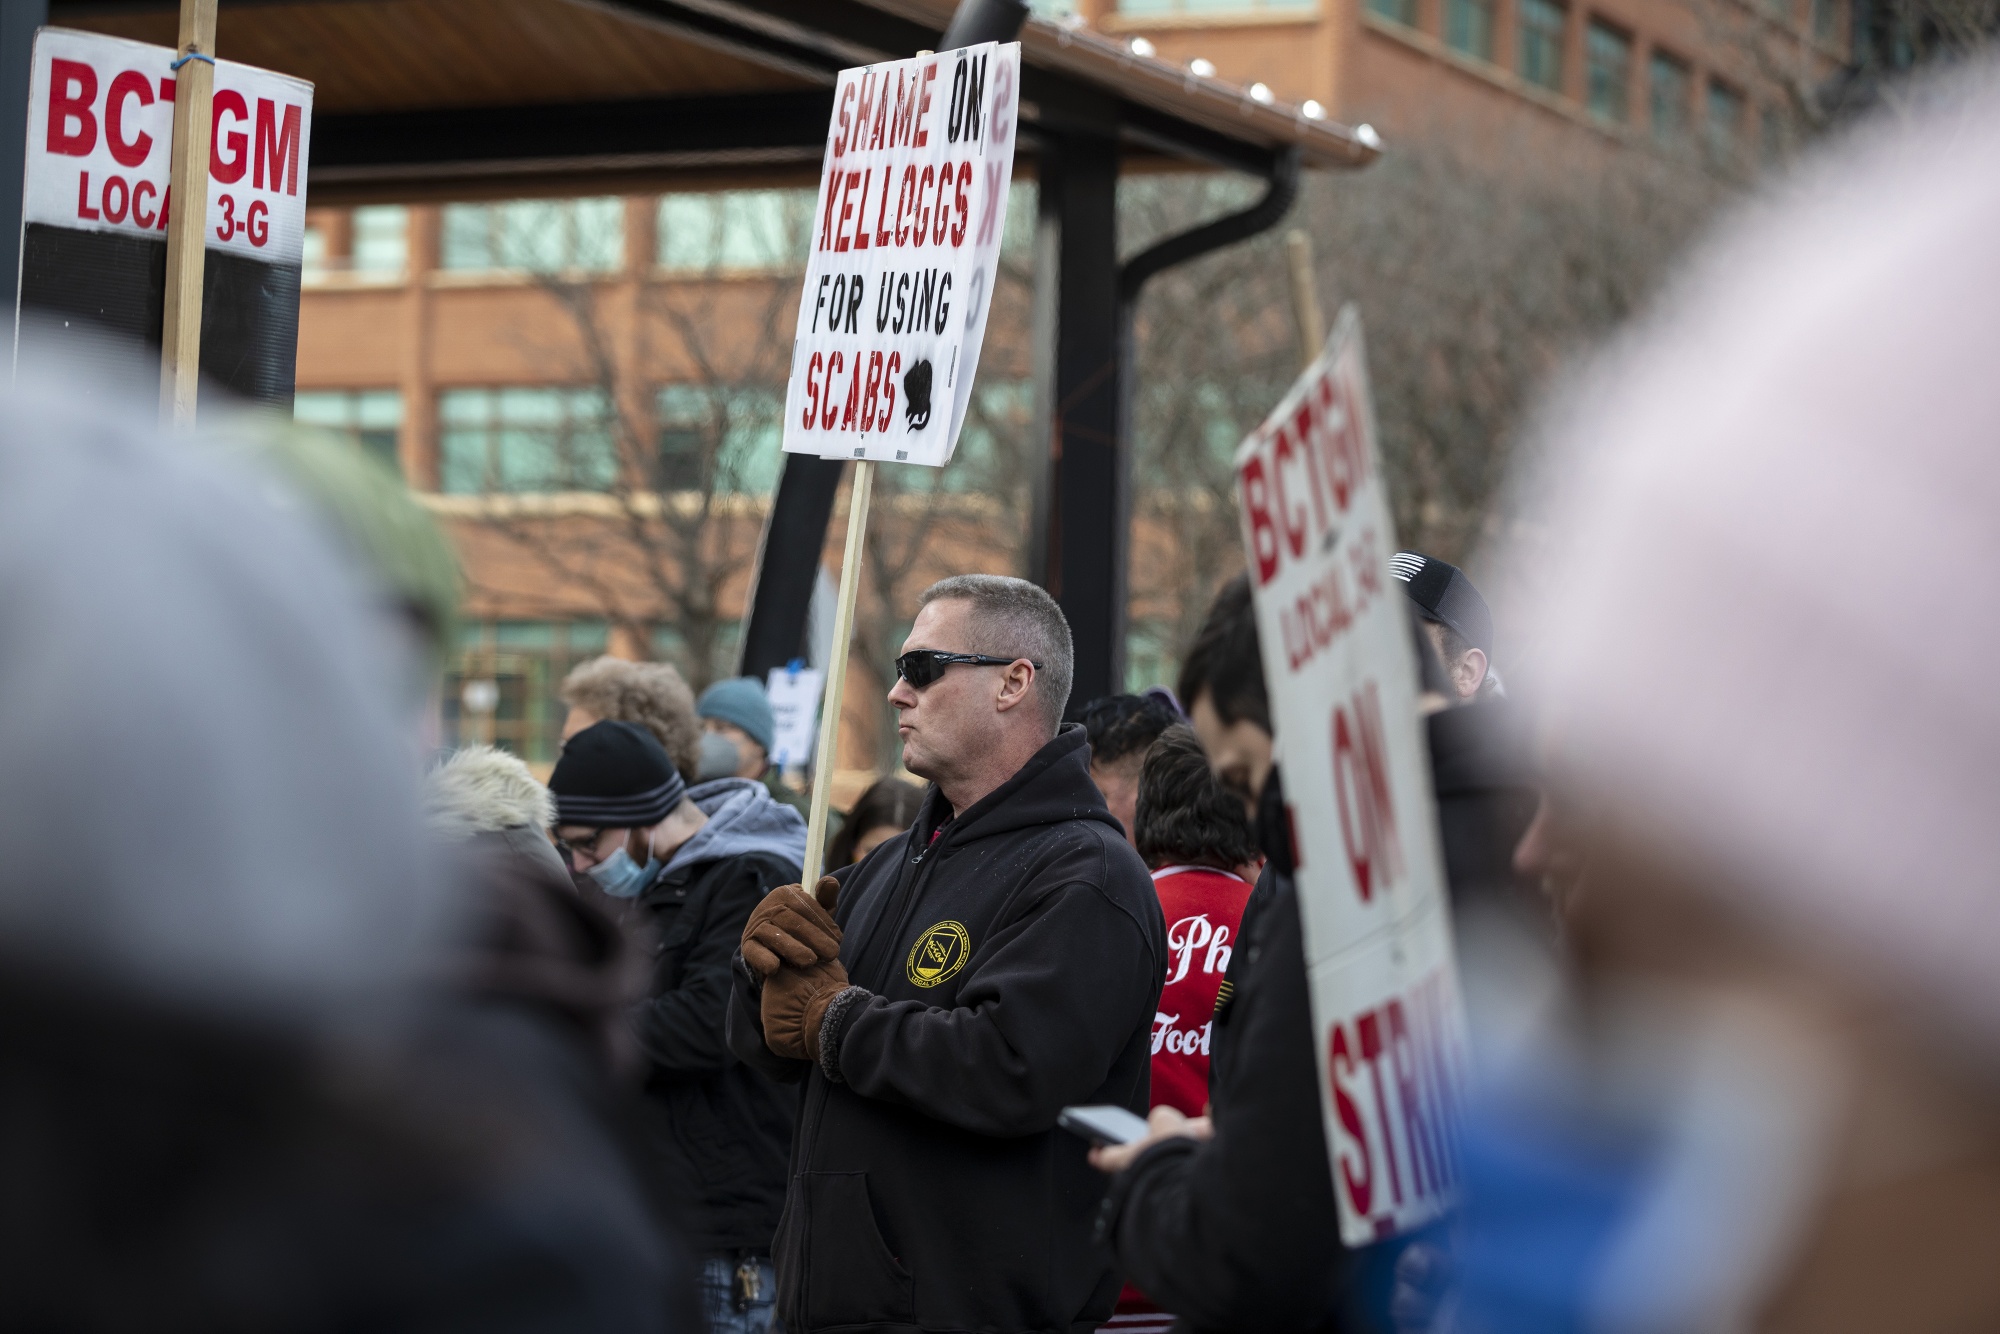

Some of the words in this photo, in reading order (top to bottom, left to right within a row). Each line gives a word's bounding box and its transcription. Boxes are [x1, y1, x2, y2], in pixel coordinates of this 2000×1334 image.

[46, 57, 302, 197] BCGM
[834, 63, 937, 158] SHAME
[948, 53, 988, 144] ON
[78, 170, 170, 231] LOC
[216, 194, 269, 247] 3-G
[819, 161, 973, 253] KELLOGGS
[812, 272, 864, 335] FOR
[876, 268, 952, 335] USING
[803, 351, 900, 433] SCABS
[1331, 680, 1407, 905] ON
